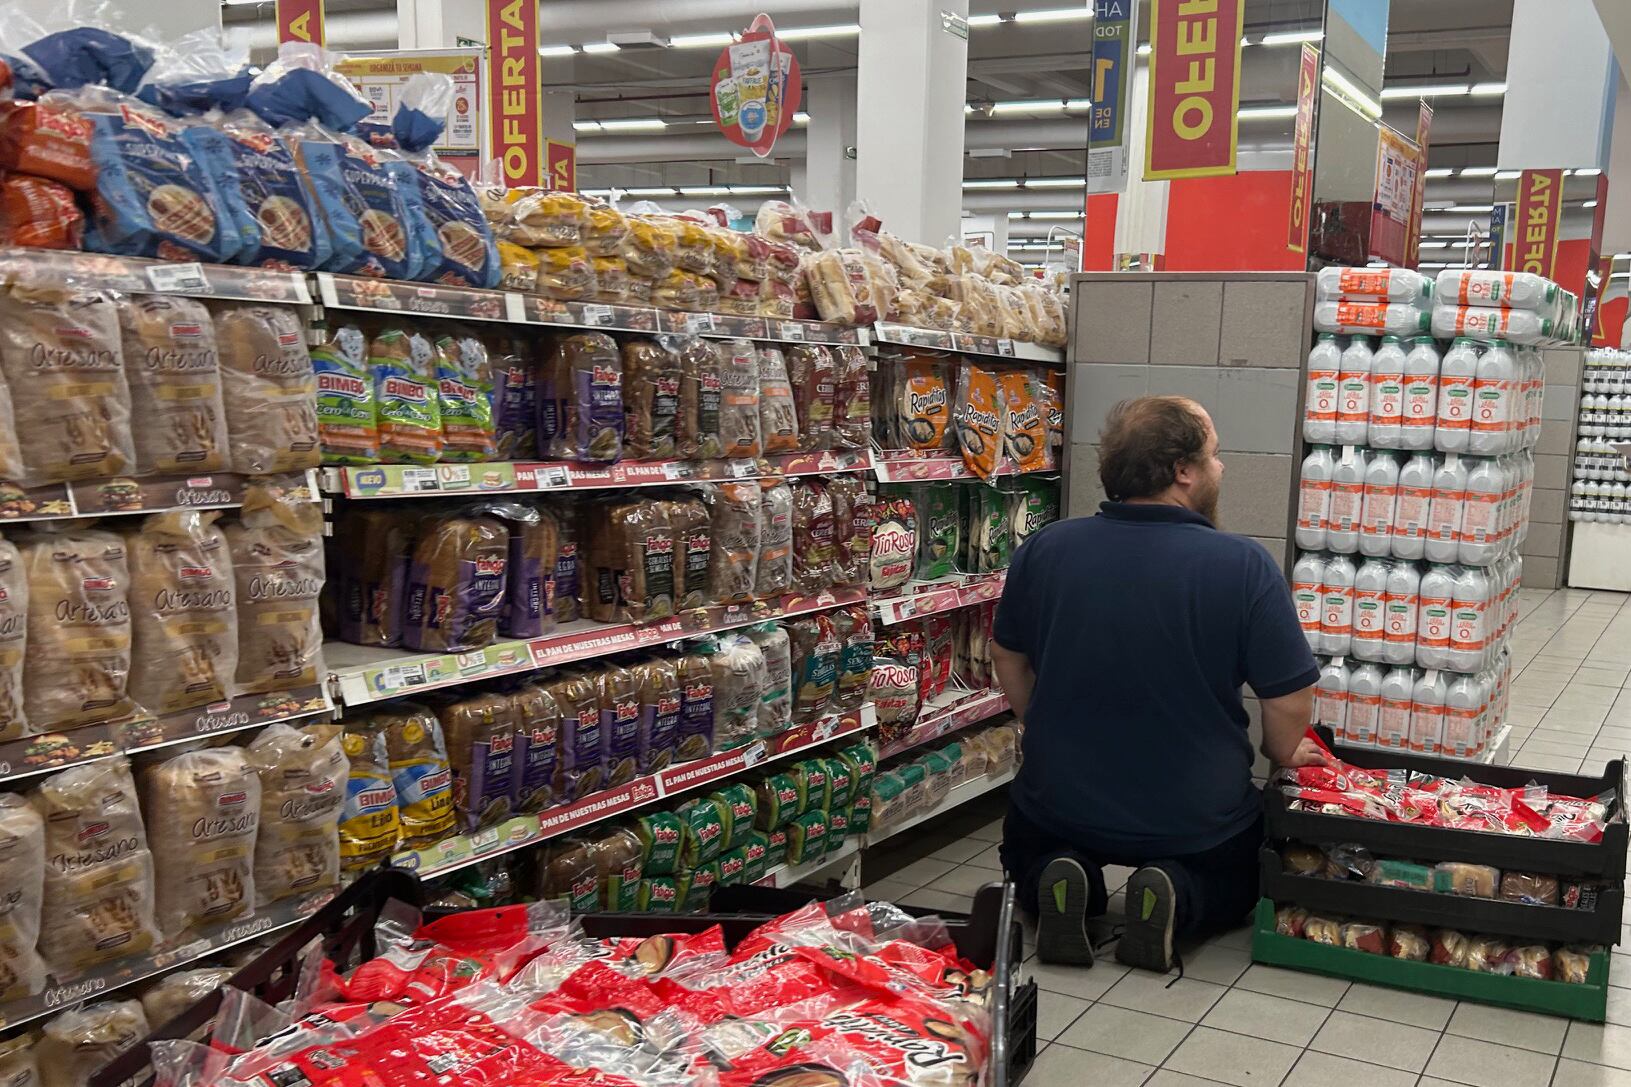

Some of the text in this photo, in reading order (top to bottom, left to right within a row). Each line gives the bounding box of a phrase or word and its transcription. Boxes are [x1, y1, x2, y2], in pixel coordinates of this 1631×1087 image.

[500, 0, 529, 179] OFERTA
[911, 387, 947, 414] Rapiditas
[964, 404, 1000, 432] Rapiditas
[476, 554, 506, 576] Fargo
[536, 632, 635, 659] EL PAN DE NUESTRAS MESAS
[665, 755, 744, 787] EL PAN DE NUESTRAS MESAS
[543, 792, 630, 829] PAN DE NUESTRAS MESAS
[655, 827, 679, 843] Fargo
[699, 823, 721, 841] Fargo
[653, 883, 676, 900] Fargo
